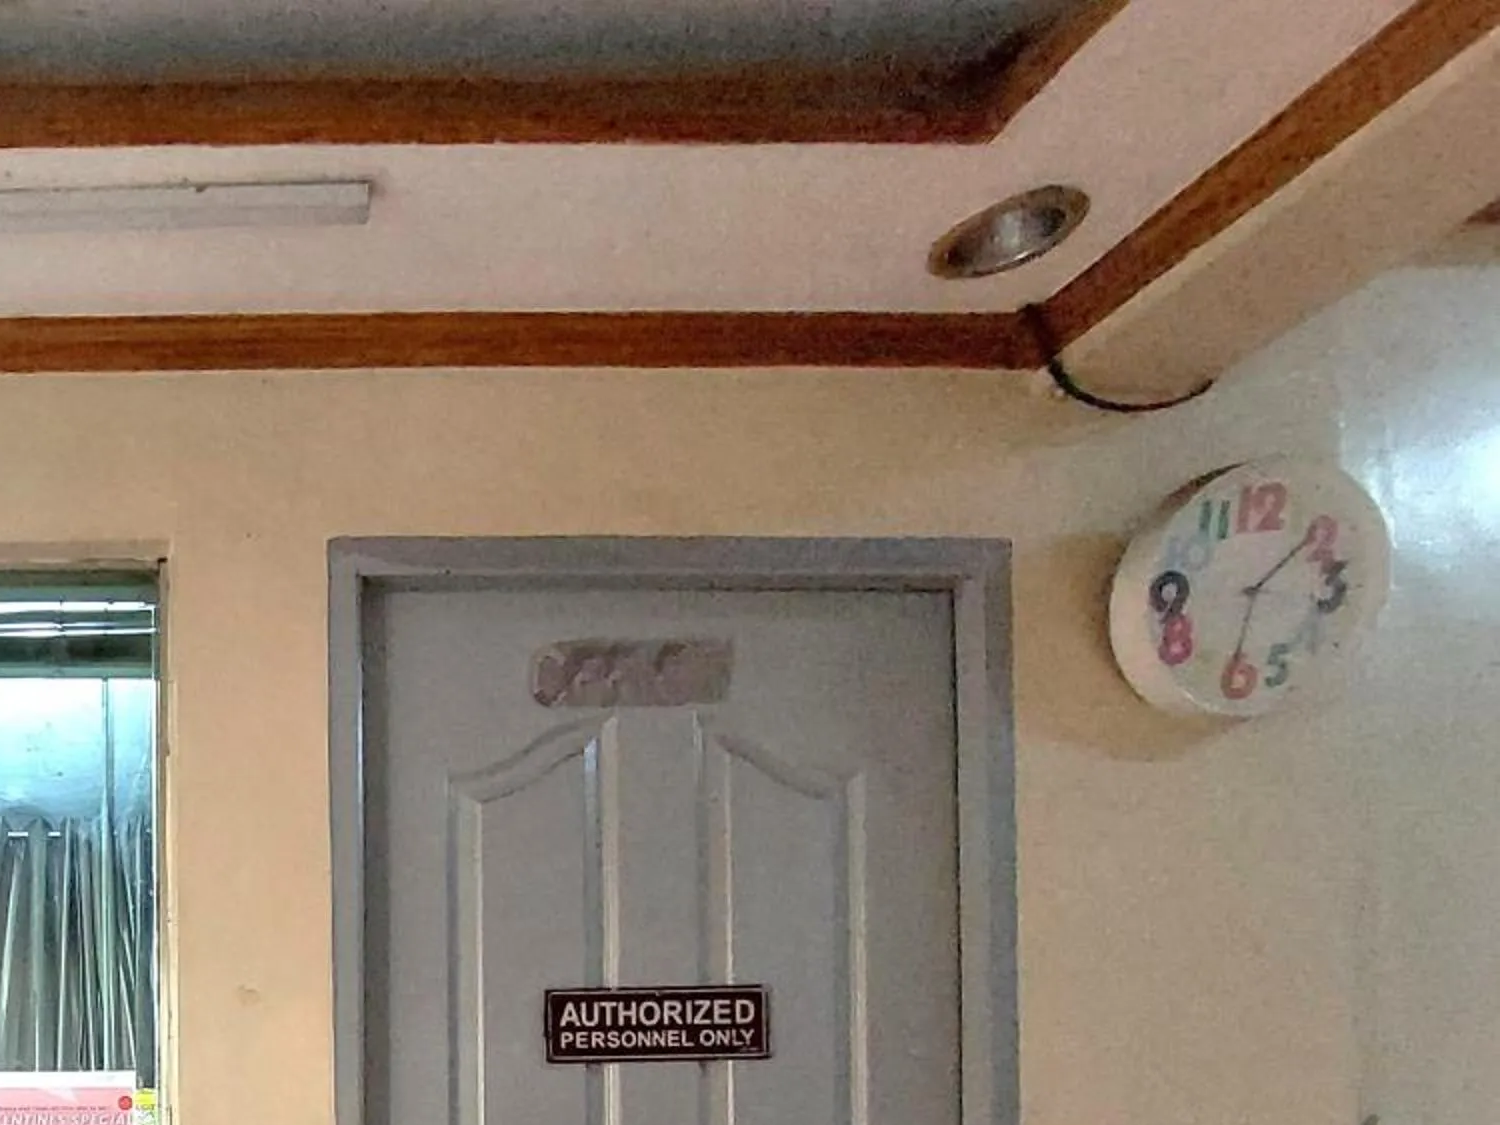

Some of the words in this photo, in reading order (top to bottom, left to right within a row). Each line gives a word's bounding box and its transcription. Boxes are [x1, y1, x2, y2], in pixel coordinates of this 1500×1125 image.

[1199, 500, 1231, 540] 11
[1235, 482, 1288, 534] 12
[1150, 570, 1190, 624] 9
[1313, 560, 1348, 614] 3
[1158, 612, 1193, 666] 8
[1220, 653, 1258, 699] 6
[1264, 642, 1290, 688] 5
[560, 998, 756, 1027] AUTHORIZED
[560, 1029, 696, 1050] PERSONNEL
[699, 1028, 756, 1048] ONLY
